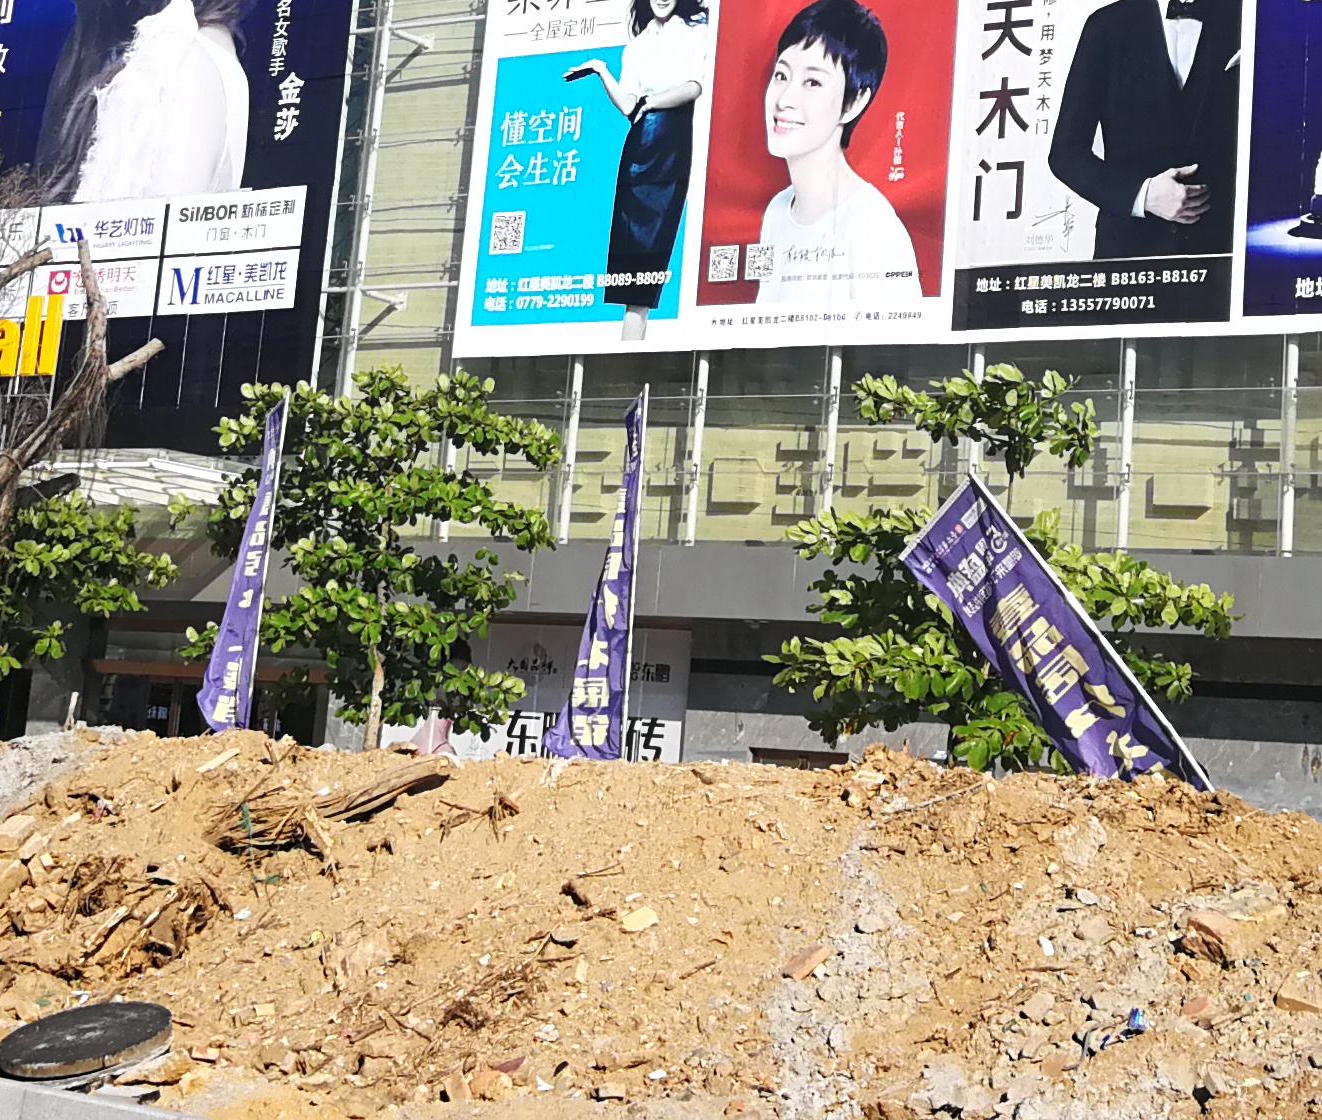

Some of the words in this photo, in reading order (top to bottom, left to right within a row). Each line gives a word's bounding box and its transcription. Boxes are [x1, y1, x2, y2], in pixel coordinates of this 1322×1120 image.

[530, 16, 596, 42] 全屋定制
[274, 72, 305, 141] 金莎
[501, 106, 583, 147] 懂空间
[495, 149, 581, 190] 会生活
[94, 218, 155, 238] 华艺灯饰
[167, 266, 204, 306] M
[1111, 269, 1208, 286] B8163-B8167
[204, 288, 285, 304] MACALLINE
